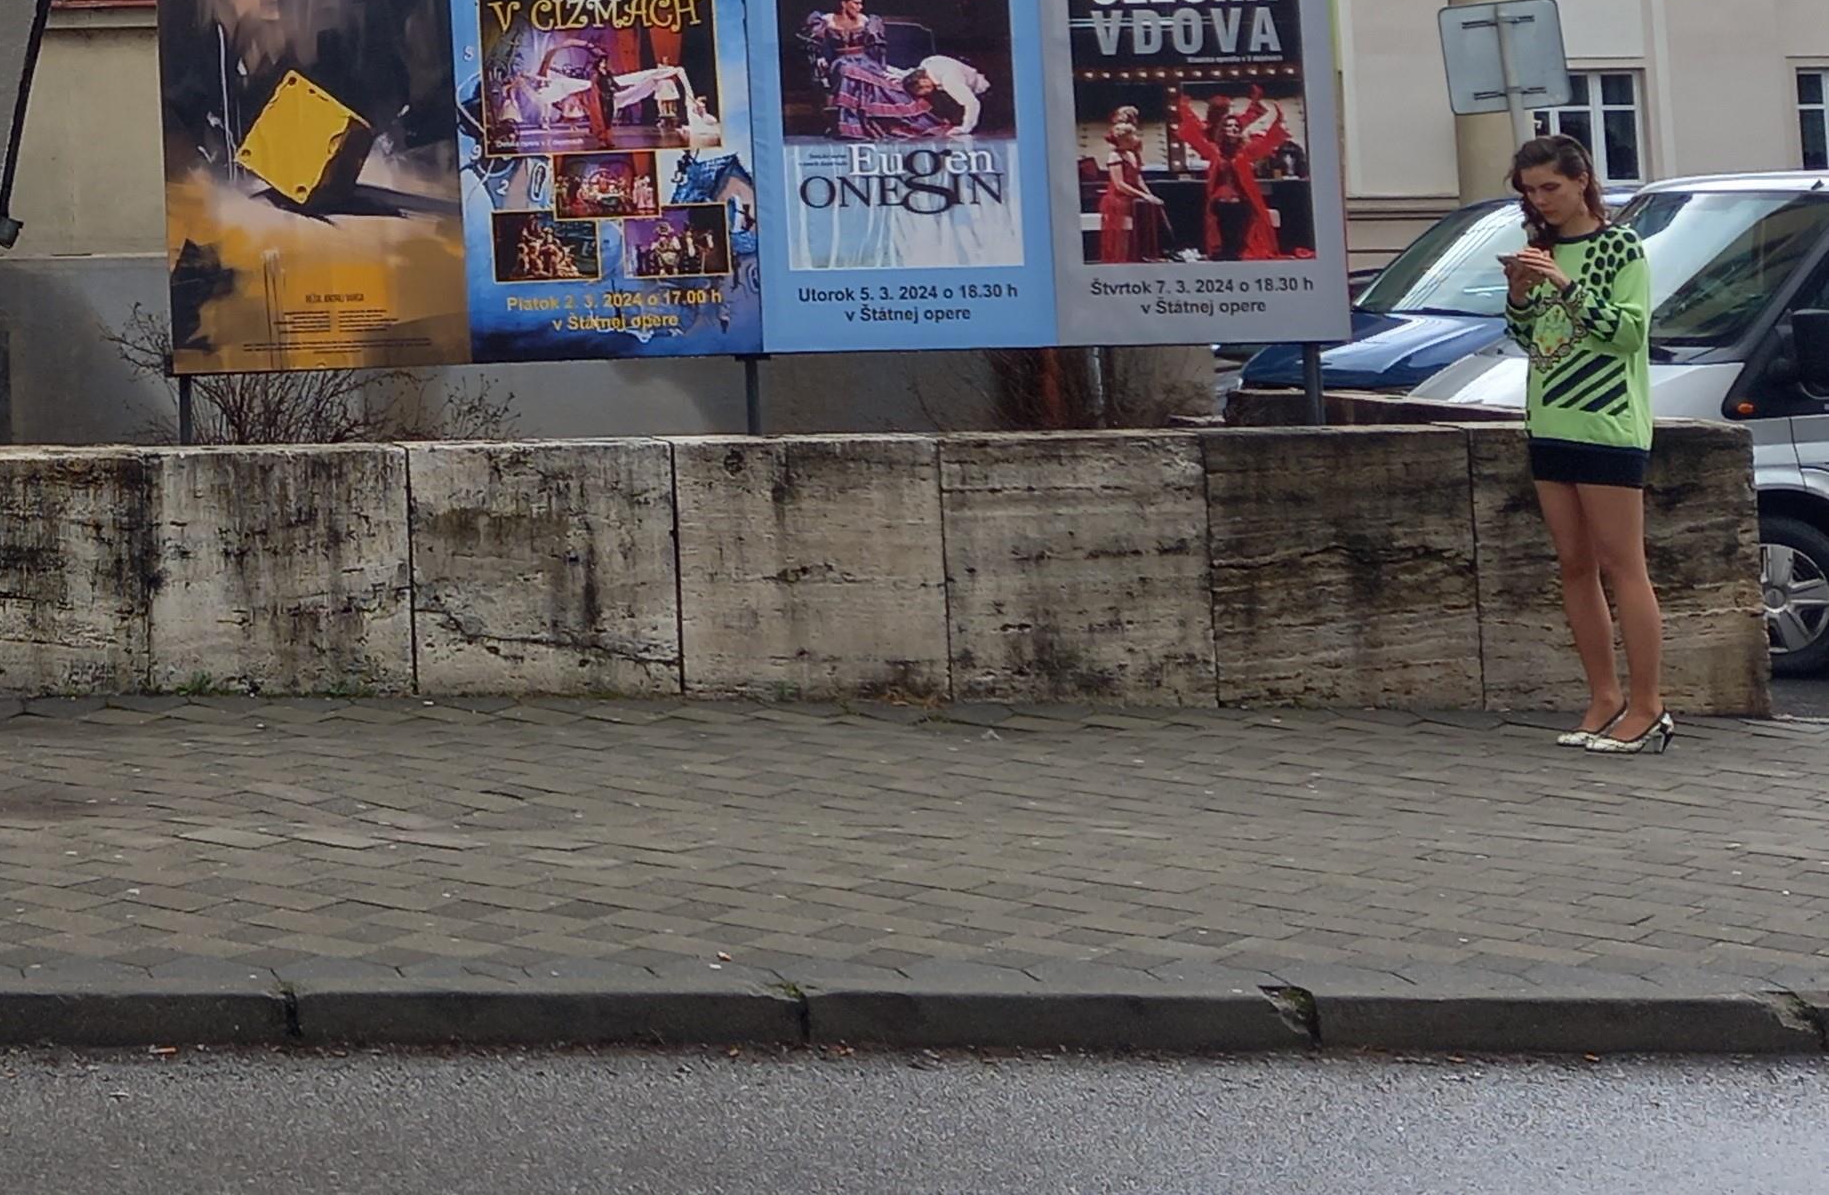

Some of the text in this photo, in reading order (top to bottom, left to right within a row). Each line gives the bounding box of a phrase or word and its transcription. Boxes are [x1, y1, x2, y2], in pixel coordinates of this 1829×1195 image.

[1089, 6, 1283, 56] VDOVA
[847, 142, 996, 198] Eugen
[798, 284, 1018, 302] Utorok 5. 3. 2024 o 18.30 h
[1090, 277, 1314, 295] Štvrtok 7. 3. 2024 o 18.30 h
[507, 297, 560, 311] Piatok
[584, 294, 598, 308] 3.
[602, 293, 643, 307] 2024
[648, 294, 658, 306] o
[663, 290, 707, 305] 17.00
[711, 289, 722, 303] h
[1141, 297, 1266, 317] v Štátnej opere
[552, 313, 679, 333] v Štátnej opere
[844, 304, 971, 324] v Štátnej opere
